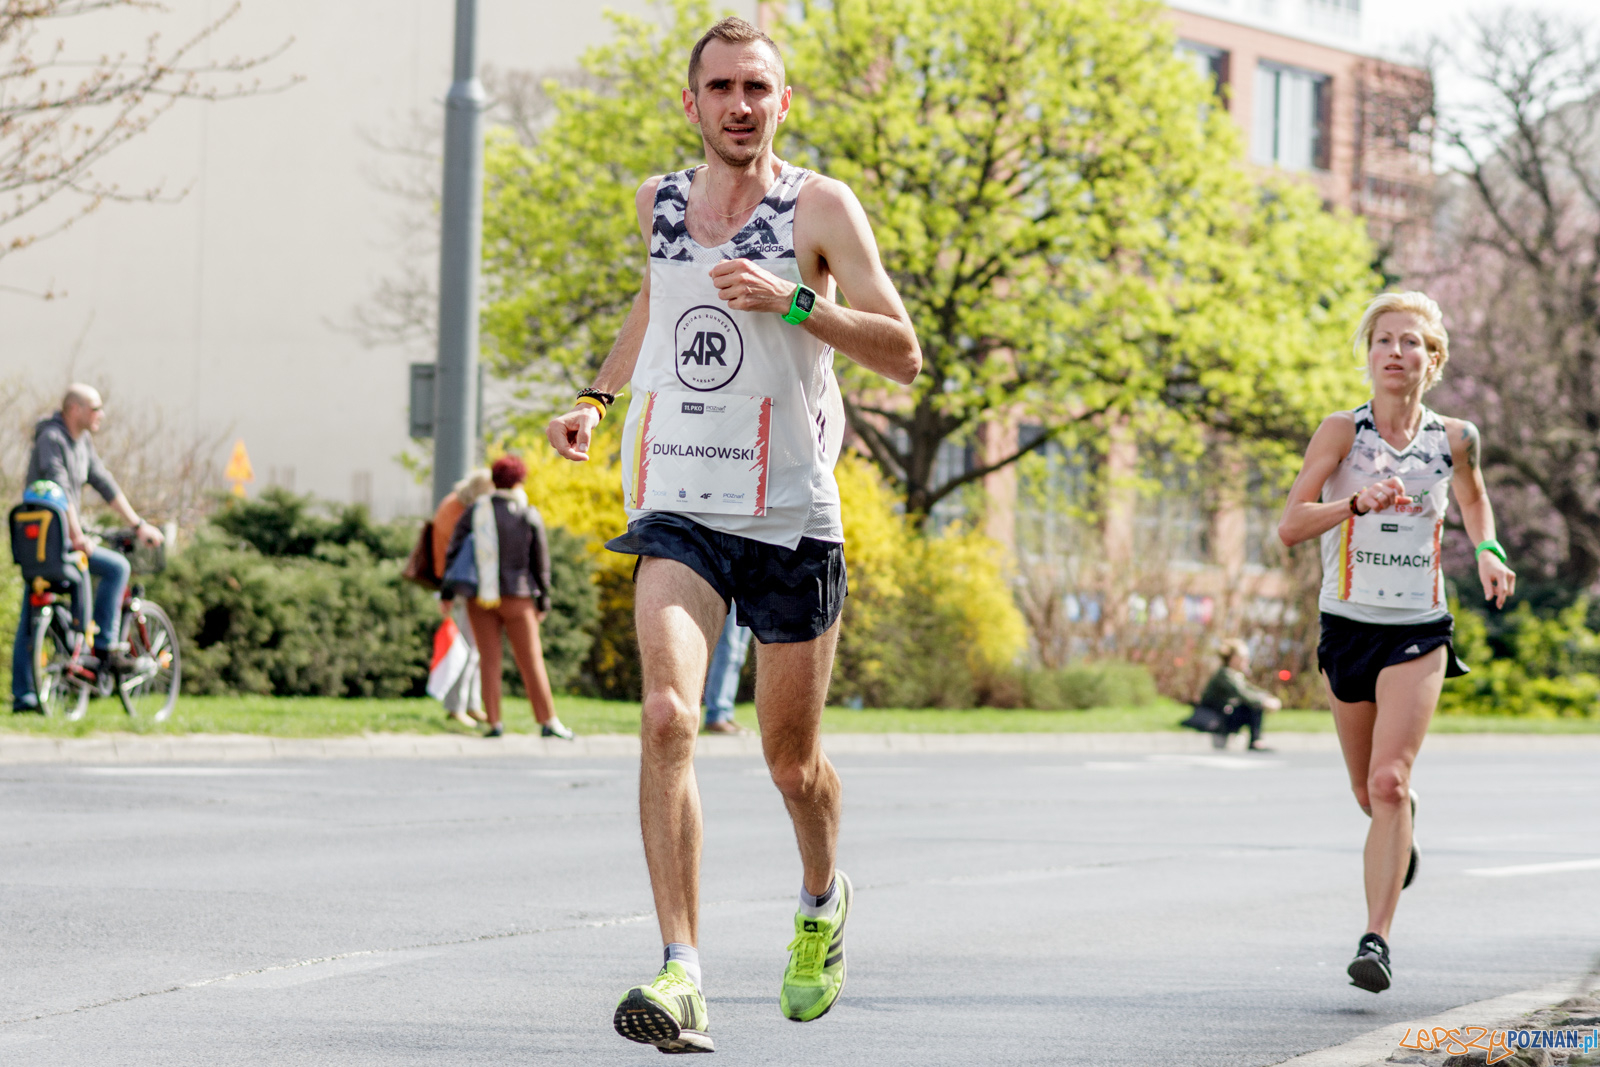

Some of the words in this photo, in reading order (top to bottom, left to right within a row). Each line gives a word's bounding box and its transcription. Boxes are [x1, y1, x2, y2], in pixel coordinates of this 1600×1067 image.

[751, 244, 784, 252] adidas
[683, 314, 702, 331] ADIDAS
[705, 313, 731, 333] RUNNERS
[680, 331, 727, 366] AR
[652, 443, 754, 461] DUKLANOWSKI
[1395, 504, 1423, 513] team
[1355, 550, 1431, 568] STELMACH
